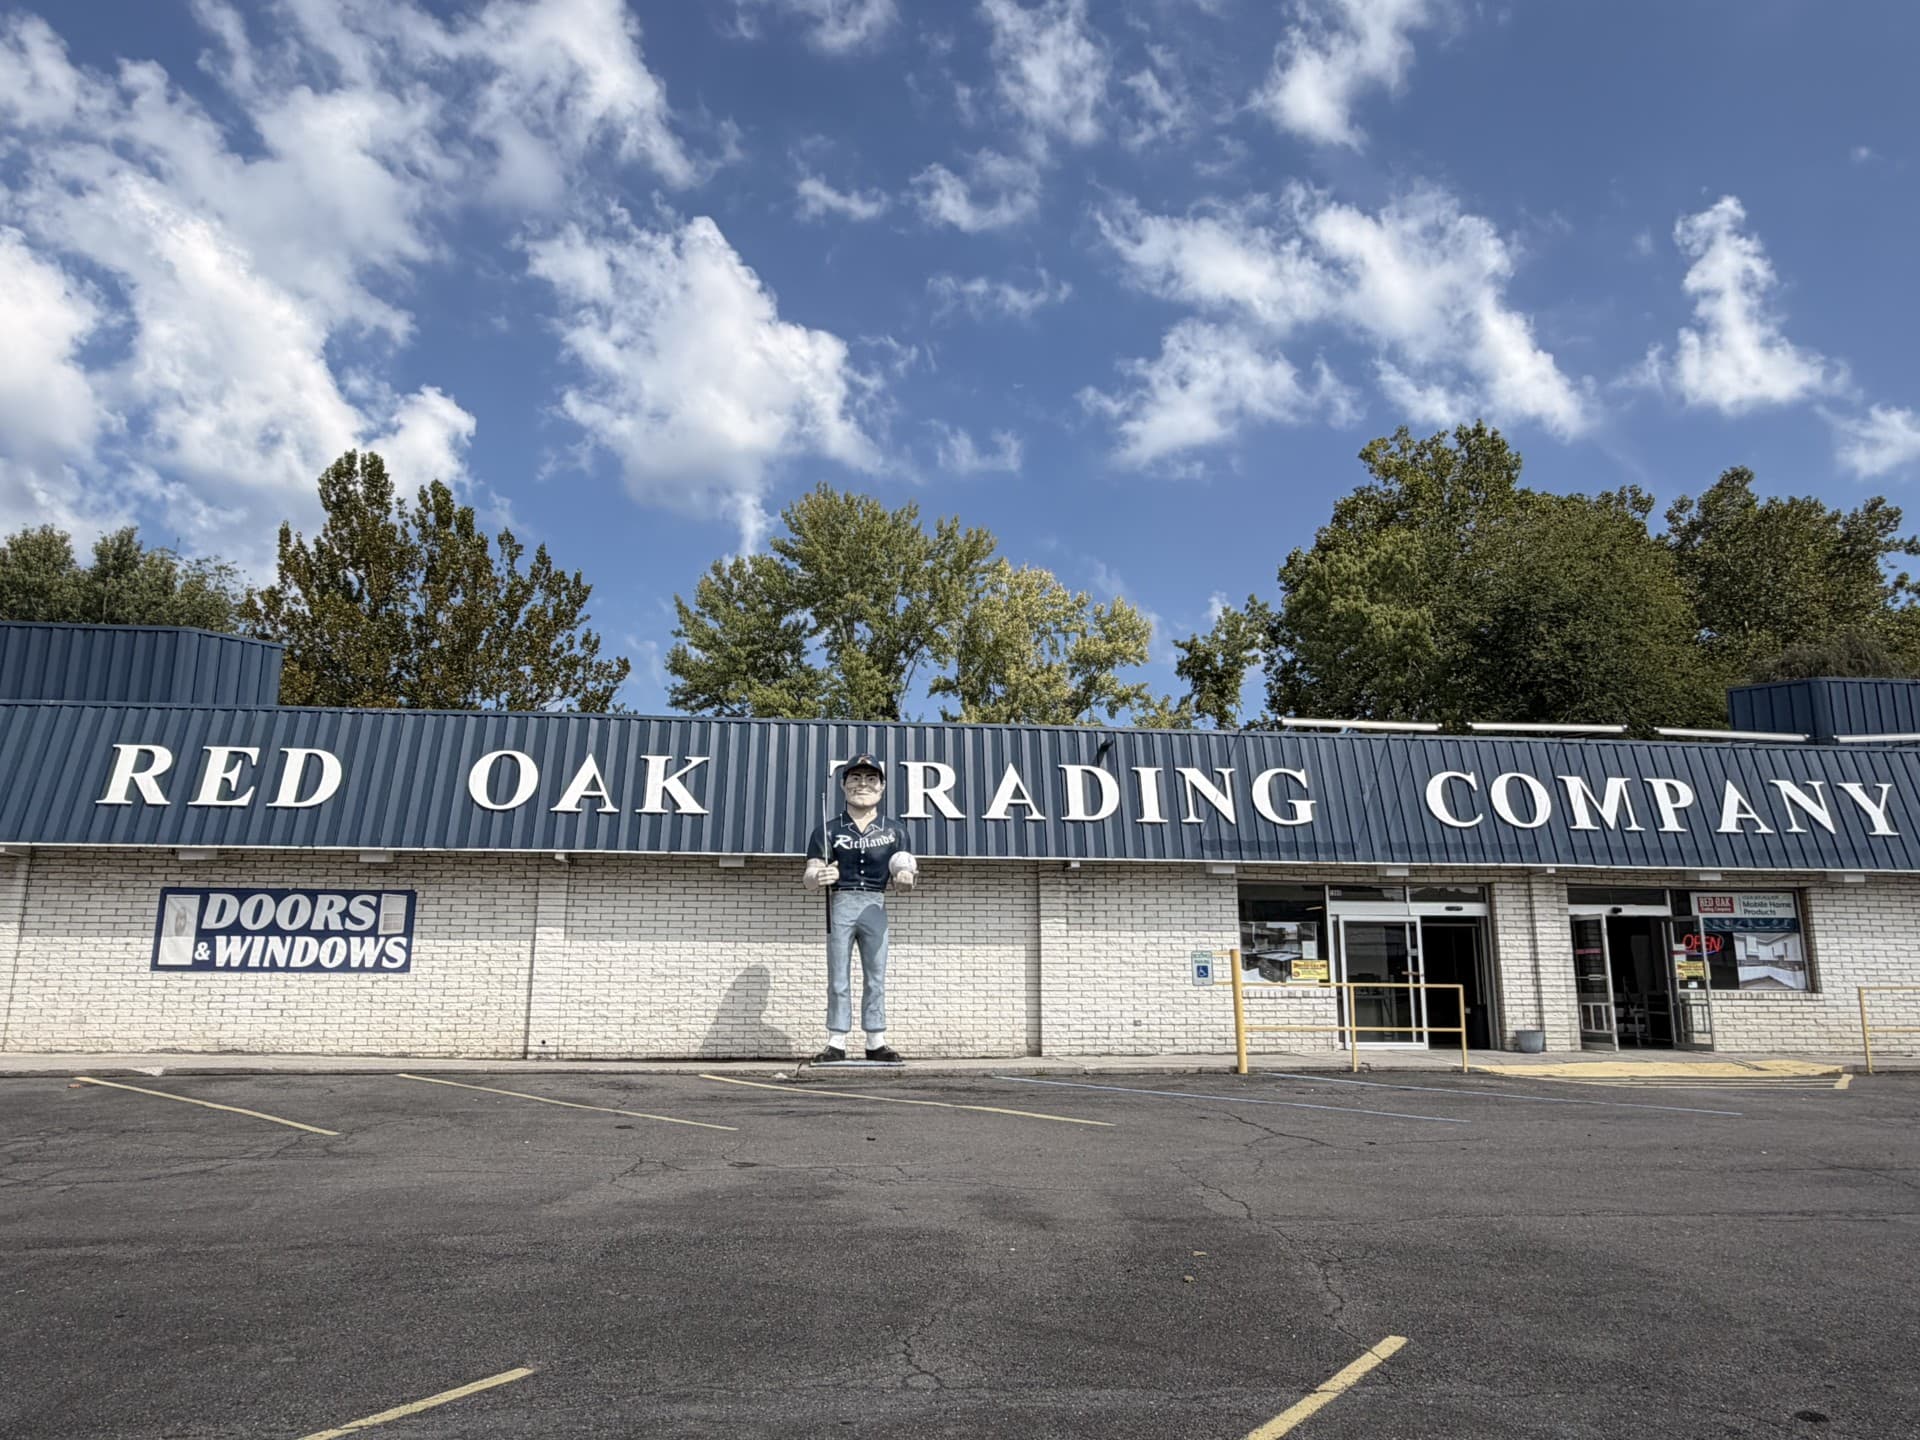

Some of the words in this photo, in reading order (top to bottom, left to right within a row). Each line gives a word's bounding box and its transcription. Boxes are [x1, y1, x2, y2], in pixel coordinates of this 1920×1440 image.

[95, 743, 343, 808] RED
[468, 750, 711, 815] OAK
[1425, 771, 1900, 837] COMPANY
[833, 829, 897, 850] Richlands
[201, 893, 378, 932] DOORS
[1699, 897, 1714, 907] RED
[1715, 897, 1731, 907] OAK
[193, 941, 211, 961] &
[215, 936, 408, 969] WINDOWS
